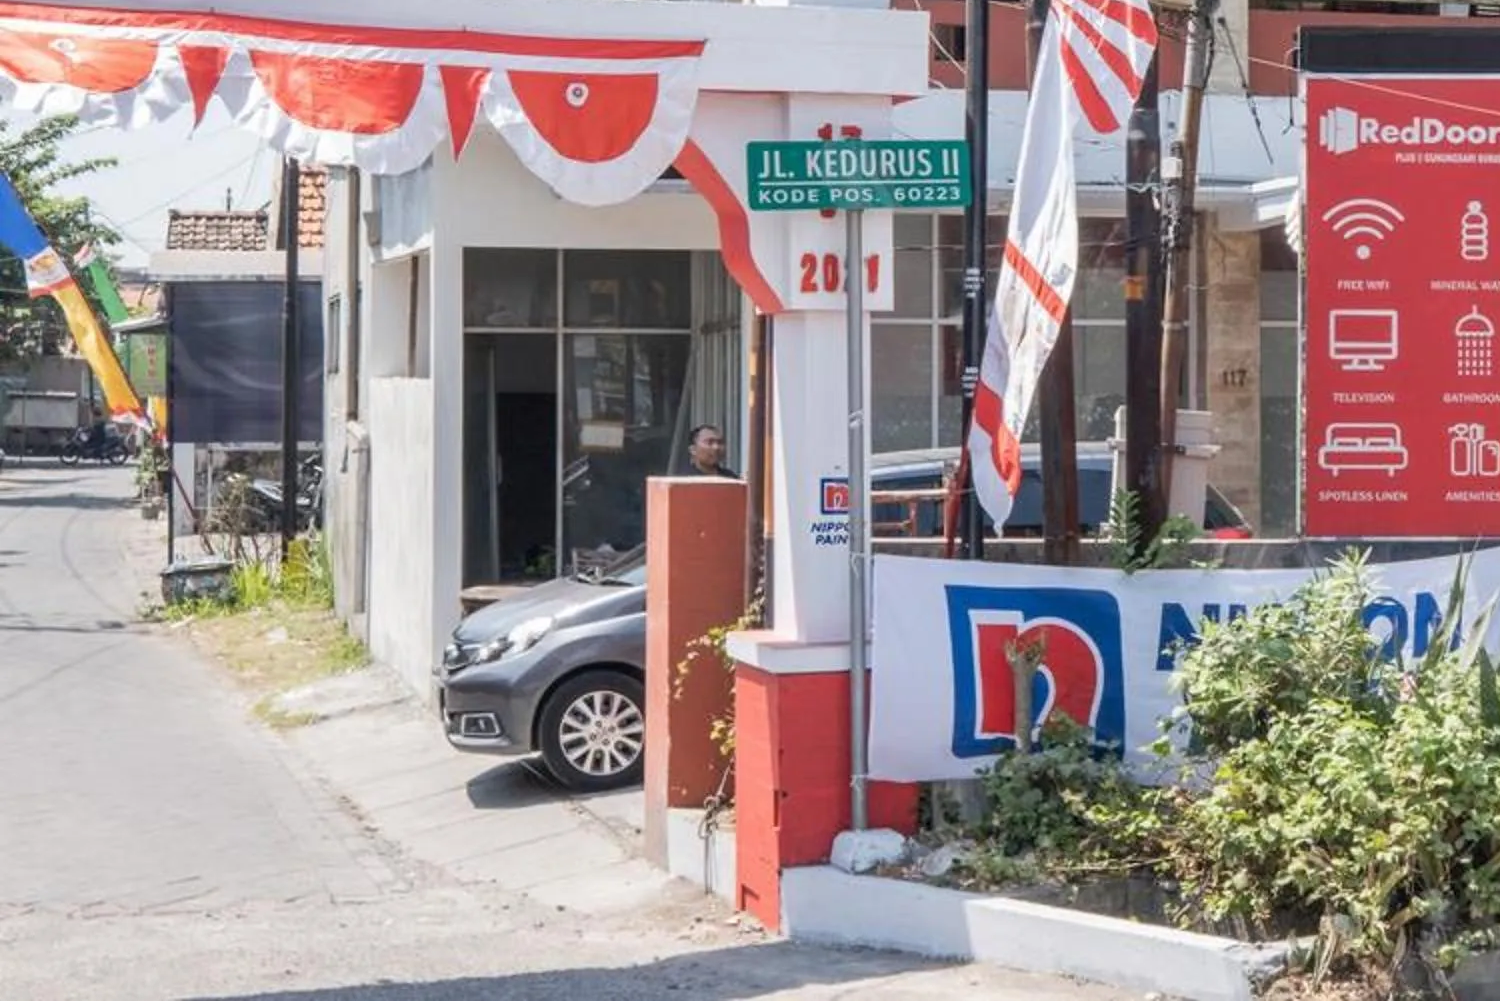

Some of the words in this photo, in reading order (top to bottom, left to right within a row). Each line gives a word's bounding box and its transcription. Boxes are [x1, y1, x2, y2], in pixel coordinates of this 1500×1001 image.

[758, 149, 796, 179] JL.
[805, 149, 933, 179] KEDURUS
[942, 149, 959, 177] II
[758, 189, 819, 204] KODE
[830, 187, 882, 203] POS.
[894, 187, 961, 201] 60223
[800, 253, 880, 293] 201
[1337, 280, 1364, 291] FREE
[1430, 280, 1478, 291] MINERAL
[1222, 369, 1248, 388] 117
[1333, 392, 1395, 403] TELEVISION
[1318, 491, 1374, 502] SPOTLESS
[1375, 492, 1408, 502] LINEN
[815, 534, 848, 546] PAIN
